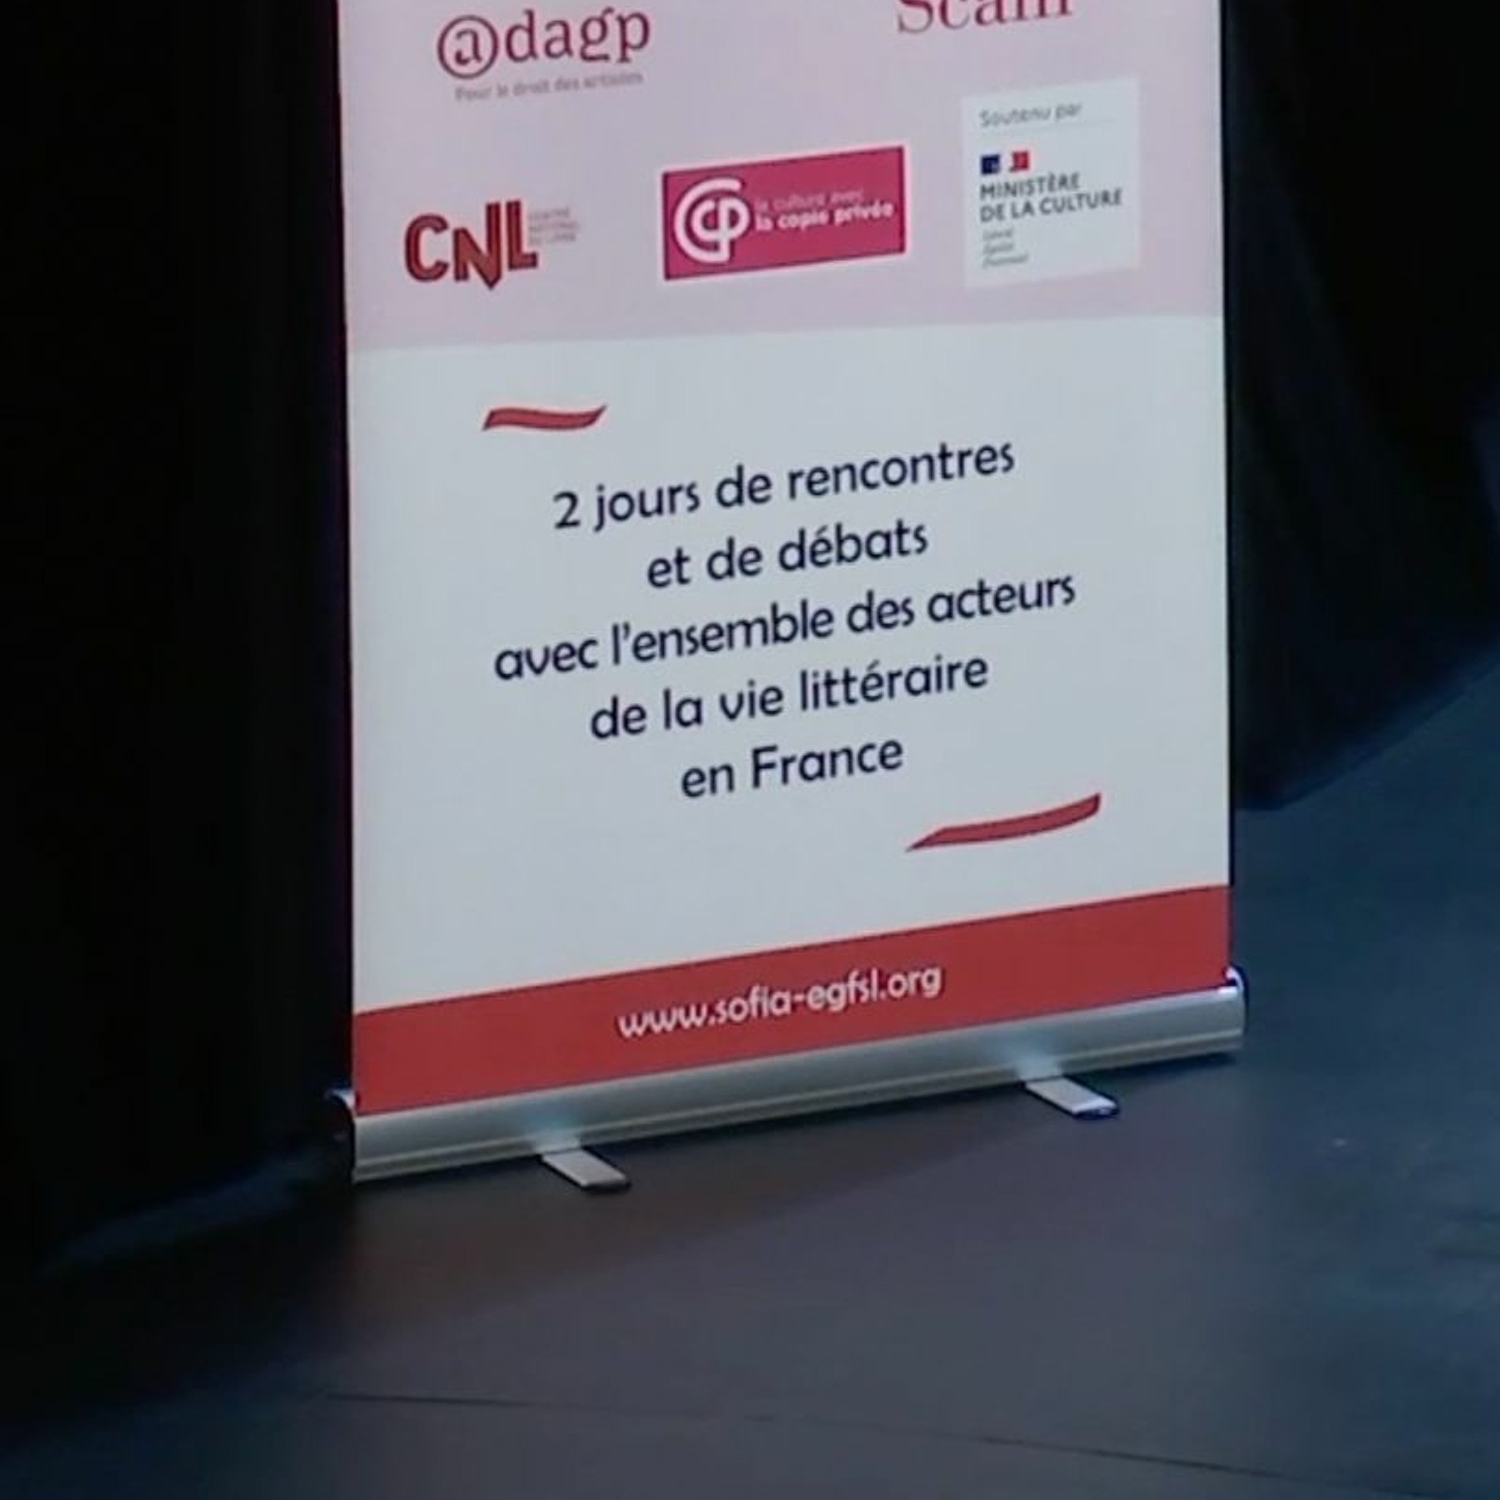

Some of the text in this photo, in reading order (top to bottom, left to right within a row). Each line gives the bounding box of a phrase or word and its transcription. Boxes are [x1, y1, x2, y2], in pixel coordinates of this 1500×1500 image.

[980, 172, 1080, 201] MINISTÈRE
[980, 188, 1124, 222] DE LA CULTURE
[405, 200, 538, 290] CNL
[554, 441, 1016, 532] 2 jours de rencontres
[646, 518, 930, 590] et de débats
[493, 638, 599, 681] avec
[847, 590, 915, 634] des
[928, 570, 1077, 622] acteurs
[589, 654, 990, 740] de la vie littéraire
[680, 736, 905, 800] en France
[617, 964, 942, 1038] www.sofia-egfsl.org
